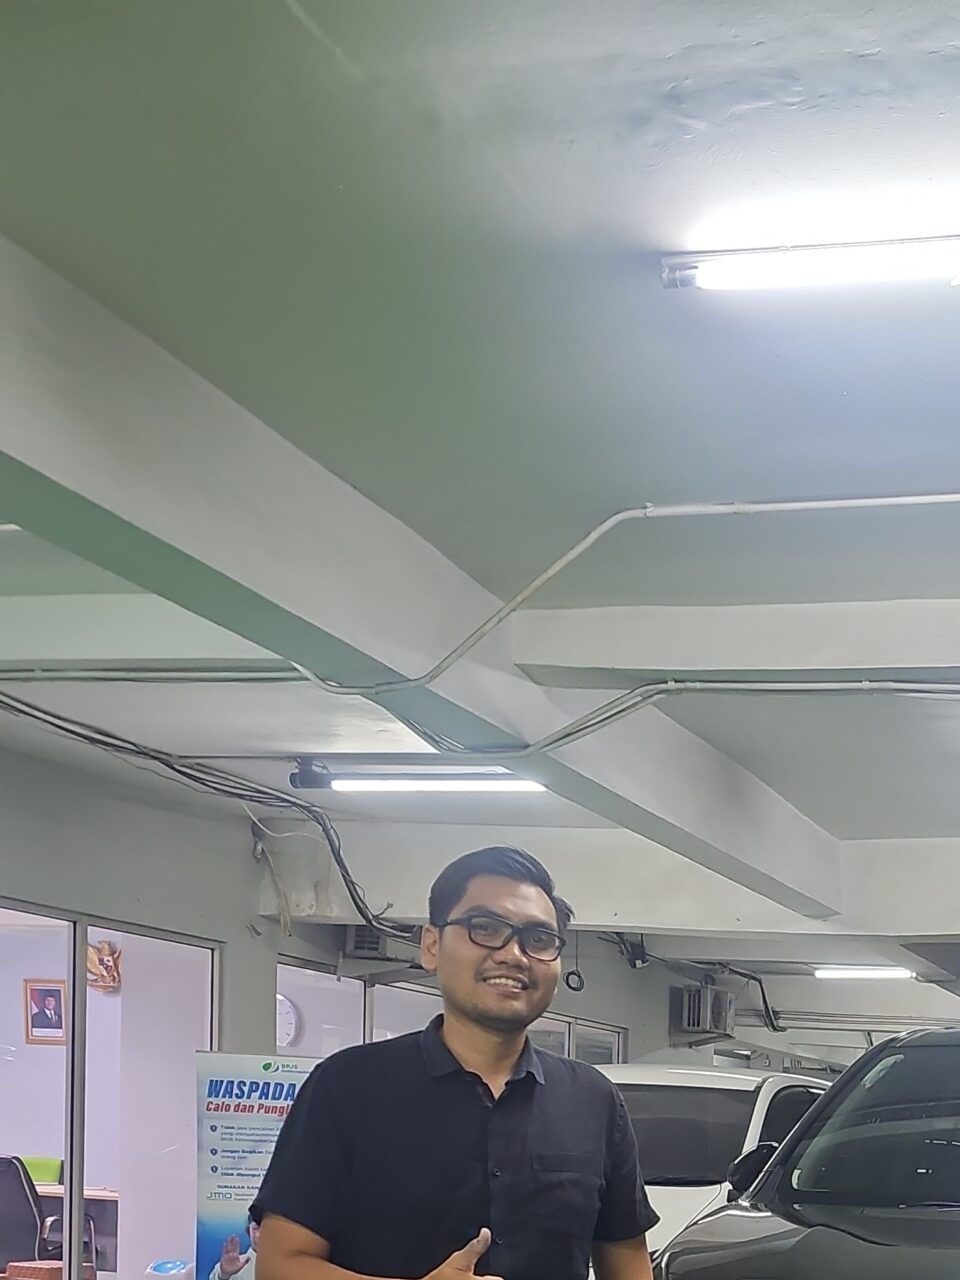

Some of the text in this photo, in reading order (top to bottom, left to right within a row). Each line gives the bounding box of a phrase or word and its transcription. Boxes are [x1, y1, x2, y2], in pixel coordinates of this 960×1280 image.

[207, 1079, 297, 1102] WASPADA
[206, 1101, 231, 1112] Calo
[233, 1102, 254, 1113] dan
